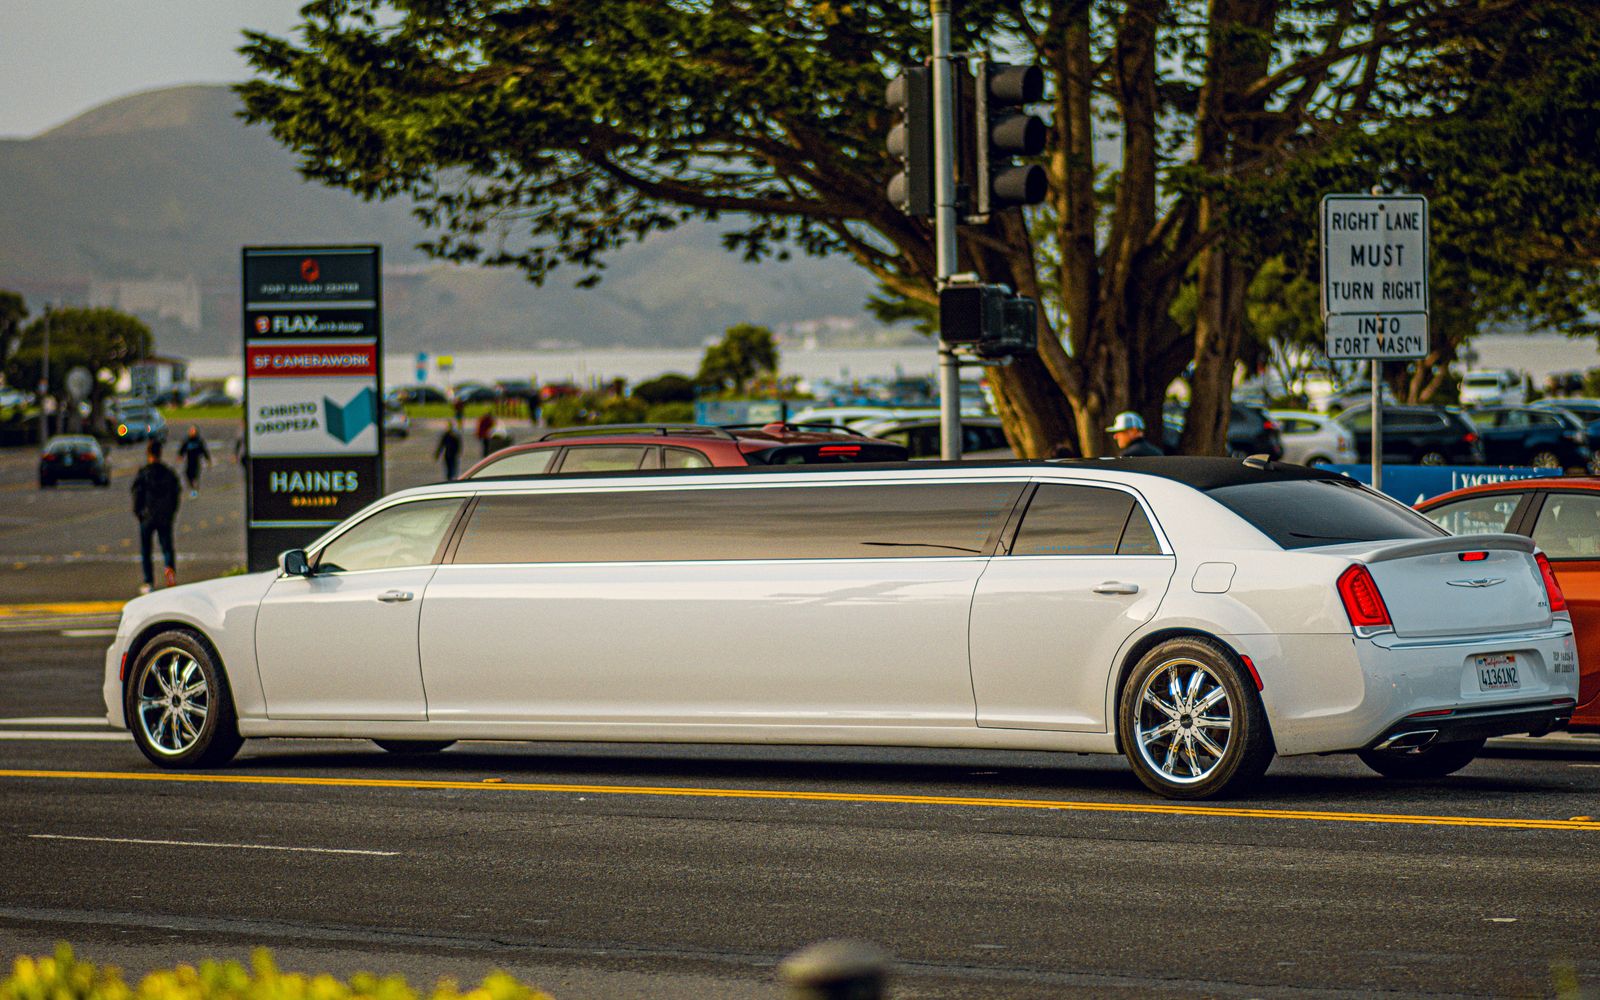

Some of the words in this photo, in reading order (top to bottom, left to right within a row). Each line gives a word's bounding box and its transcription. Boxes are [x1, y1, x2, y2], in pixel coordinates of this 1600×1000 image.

[1332, 212, 1379, 231] RIGHT
[1386, 212, 1420, 231] LANE
[1351, 244, 1404, 267] MUST
[1332, 282, 1374, 300] TURN
[1382, 281, 1421, 300] RIGHT
[272, 314, 318, 333] FLAX
[1358, 317, 1400, 334] INTO
[1335, 337, 1370, 355] FORT
[254, 356, 270, 368] SF
[273, 354, 370, 368] CAMERAWORK
[260, 402, 317, 418] CHRISTO
[254, 417, 319, 435] OROPEZA
[271, 471, 358, 492] HAINES
[291, 496, 338, 507] GALLERY
[1481, 667, 1518, 686] 41361N2
